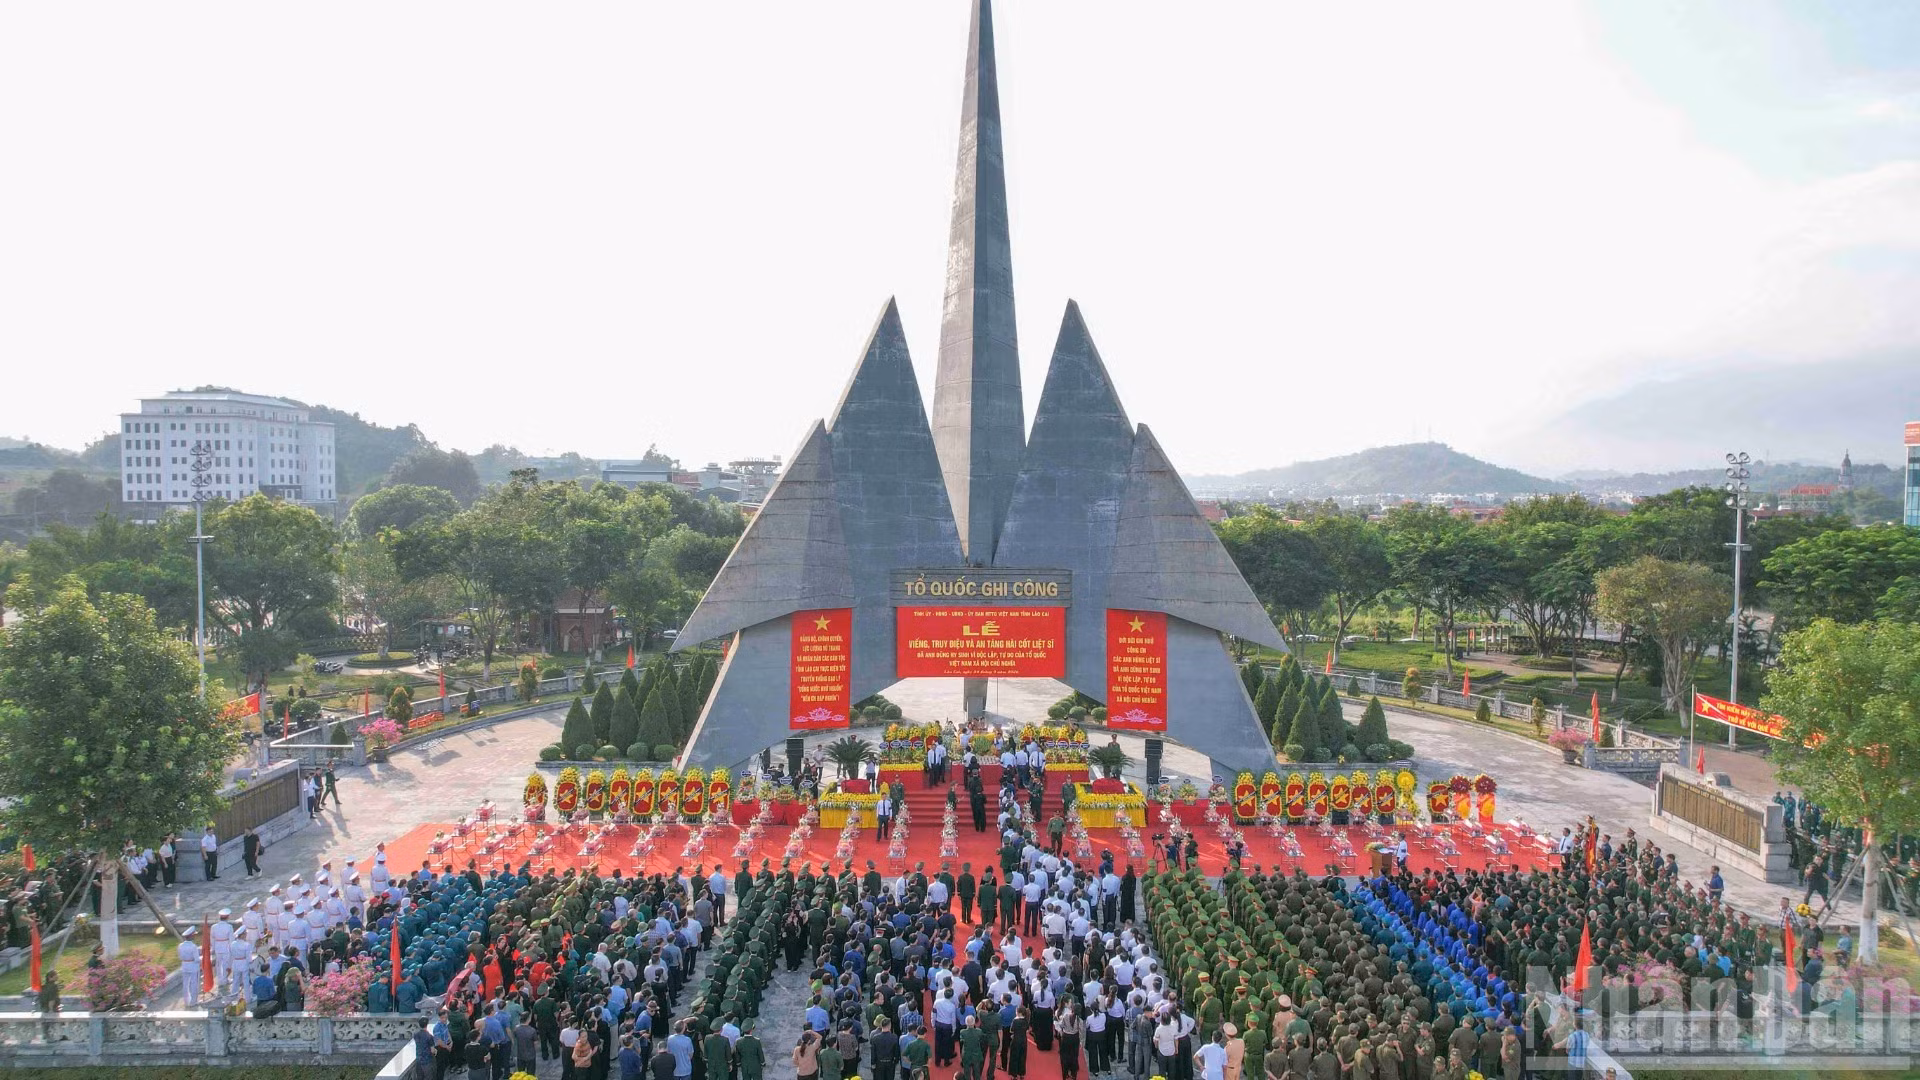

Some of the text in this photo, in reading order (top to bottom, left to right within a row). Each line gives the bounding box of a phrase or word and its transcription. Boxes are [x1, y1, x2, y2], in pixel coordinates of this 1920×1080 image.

[904, 573, 1058, 597] TỔ QUỐC GHI CÔNG
[962, 620, 1000, 636] LỄ
[908, 637, 1054, 650] VIẾNG, TRUY ĐIỆU VÀ AN TÁNG HÀI CỐT LIỆT SĨ
